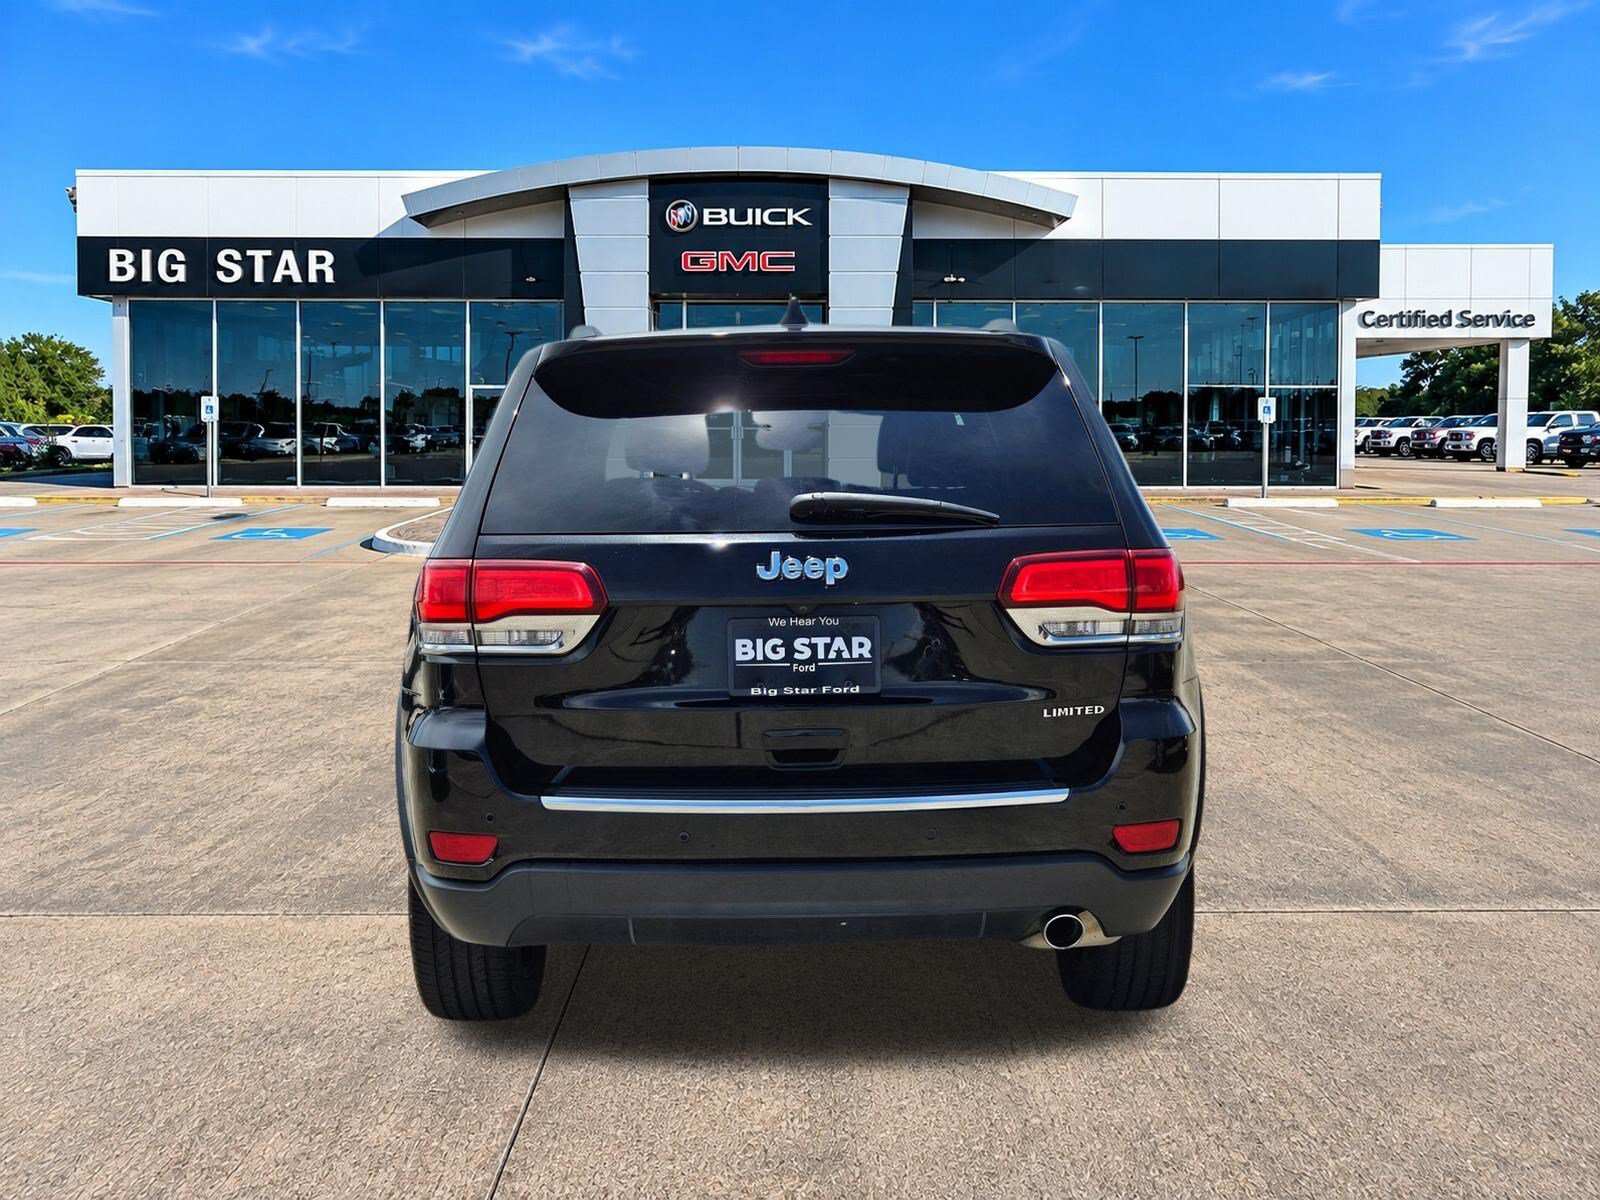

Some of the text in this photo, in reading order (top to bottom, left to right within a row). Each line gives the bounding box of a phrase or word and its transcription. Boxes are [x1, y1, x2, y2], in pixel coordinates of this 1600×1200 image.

[702, 207, 812, 227] BUICK
[108, 248, 335, 284] BIG STAR
[681, 250, 796, 273] GMC
[1360, 309, 1536, 328] Certified Service
[756, 550, 849, 586] Jeep
[768, 616, 839, 627] We Hear You
[735, 636, 872, 661] BIG STAR
[792, 663, 816, 672] Ford
[750, 685, 860, 696] Big Star Ford
[1043, 705, 1105, 718] LIMITED
